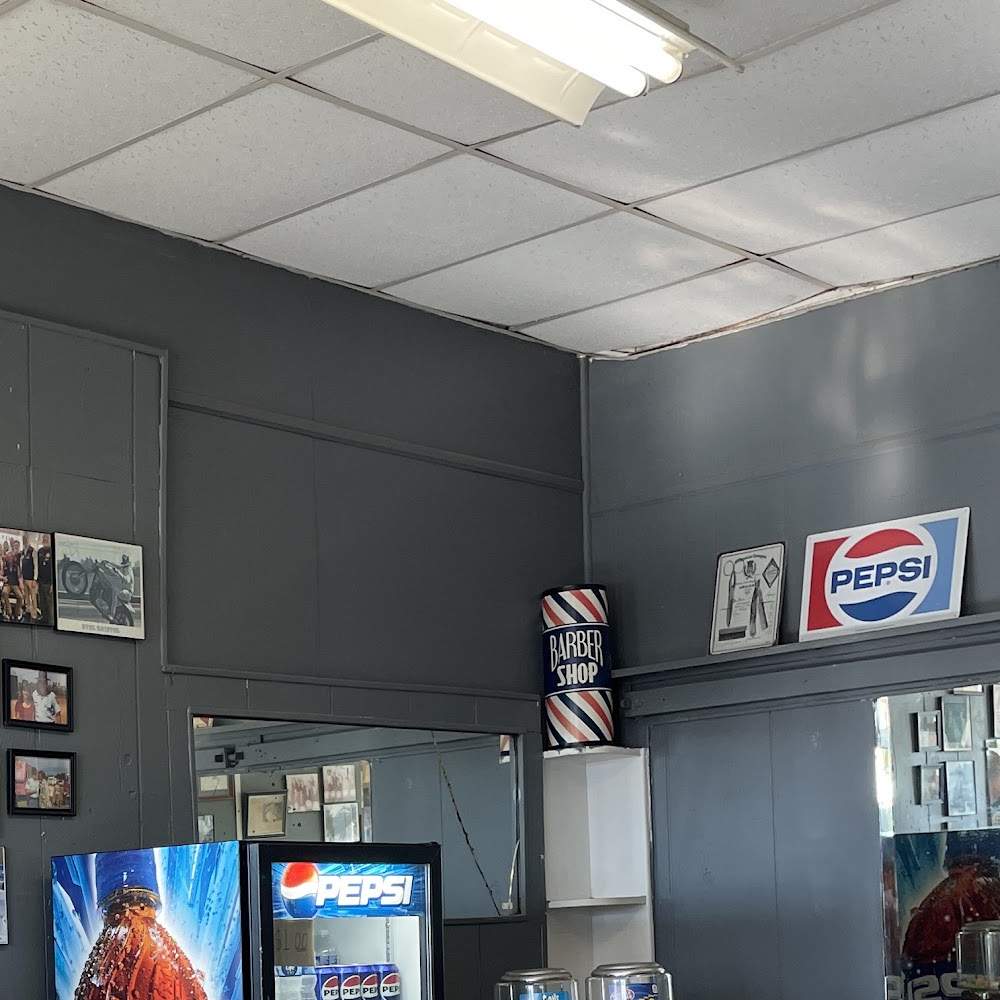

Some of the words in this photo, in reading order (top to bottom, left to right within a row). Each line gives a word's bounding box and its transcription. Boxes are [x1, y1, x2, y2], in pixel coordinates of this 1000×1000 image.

[830, 555, 931, 594] PEPSI
[550, 630, 603, 673] BARBER
[557, 662, 598, 687] SHOP
[315, 875, 414, 907] PEPSI
